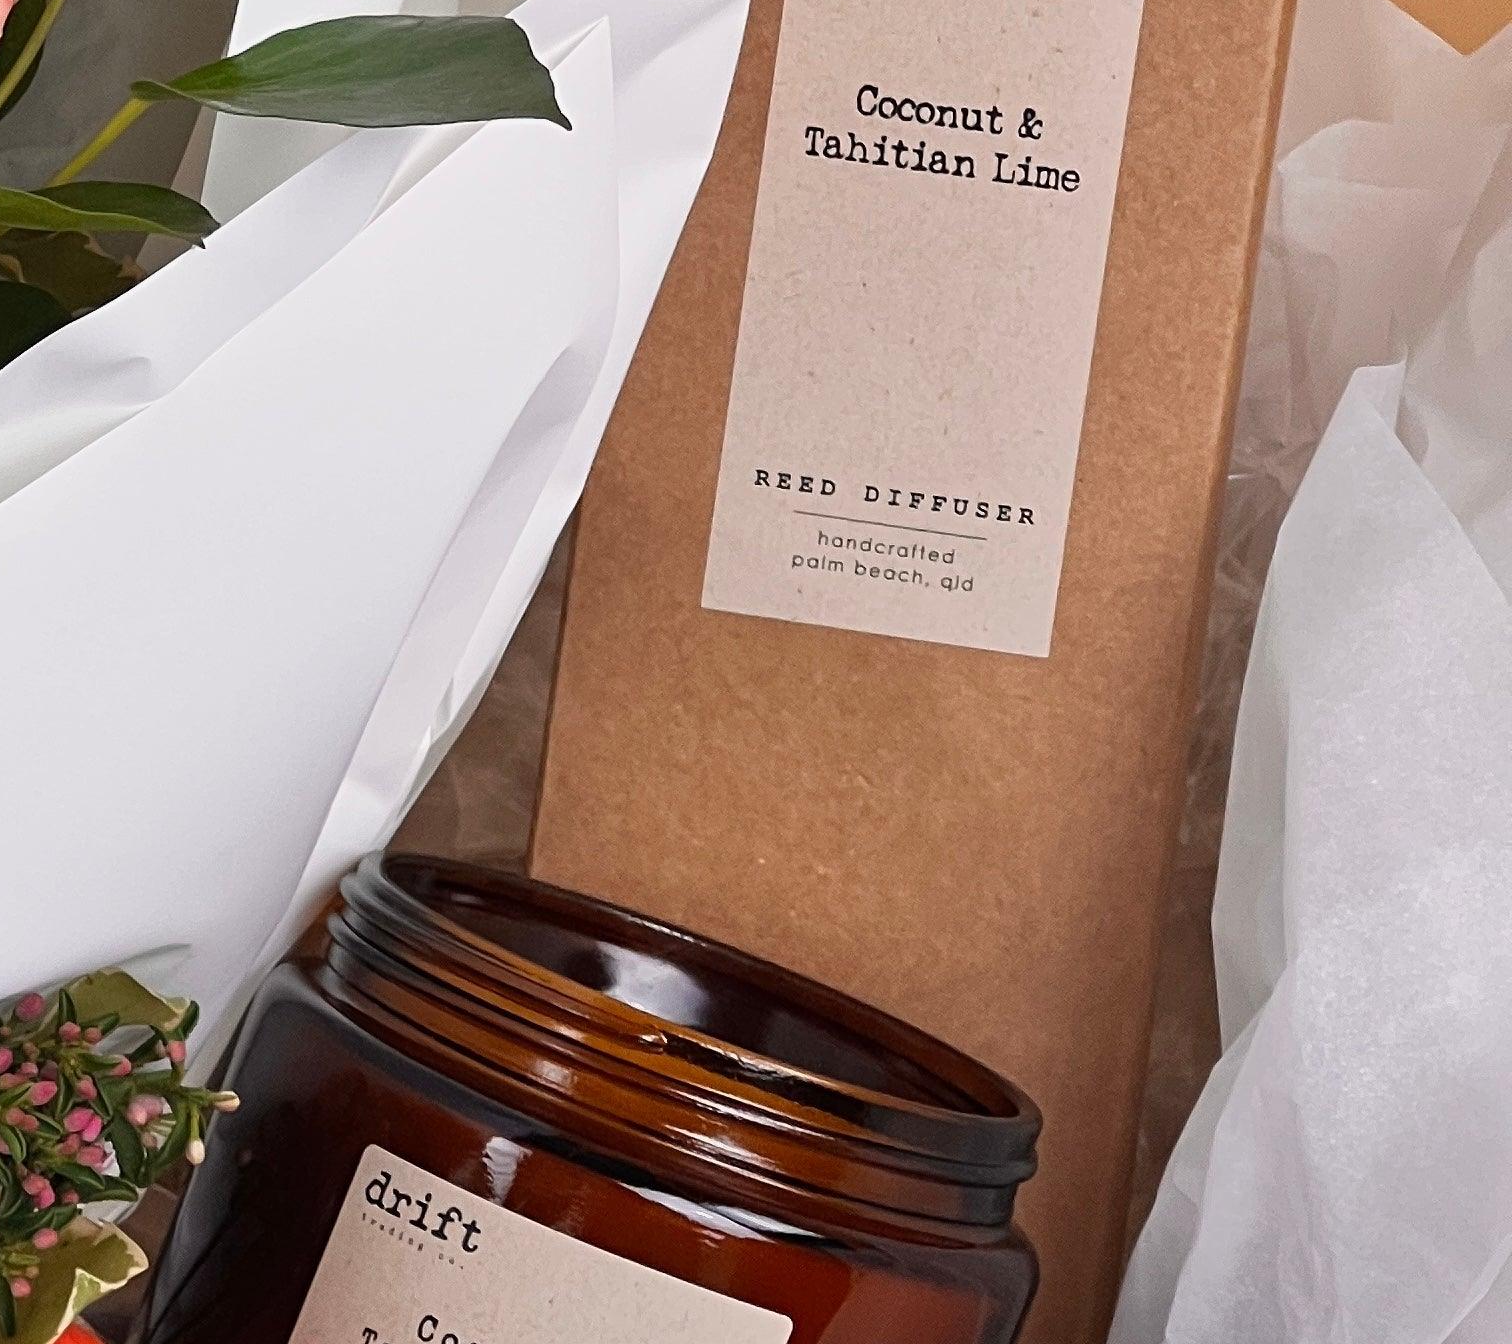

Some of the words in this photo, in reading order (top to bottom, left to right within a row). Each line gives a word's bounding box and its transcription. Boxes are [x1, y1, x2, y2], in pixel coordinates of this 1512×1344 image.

[856, 84, 1004, 135] Coconut
[1017, 108, 1044, 140] &
[804, 126, 976, 179] Tahitian
[991, 152, 1082, 193] Lime
[754, 469, 836, 496] REED
[864, 485, 1035, 525] DIFFUSER
[792, 554, 844, 573] palm
[854, 560, 931, 587] beach,
[940, 575, 975, 593] qld
[817, 530, 955, 565] handcrafted
[365, 1170, 482, 1253] drift
